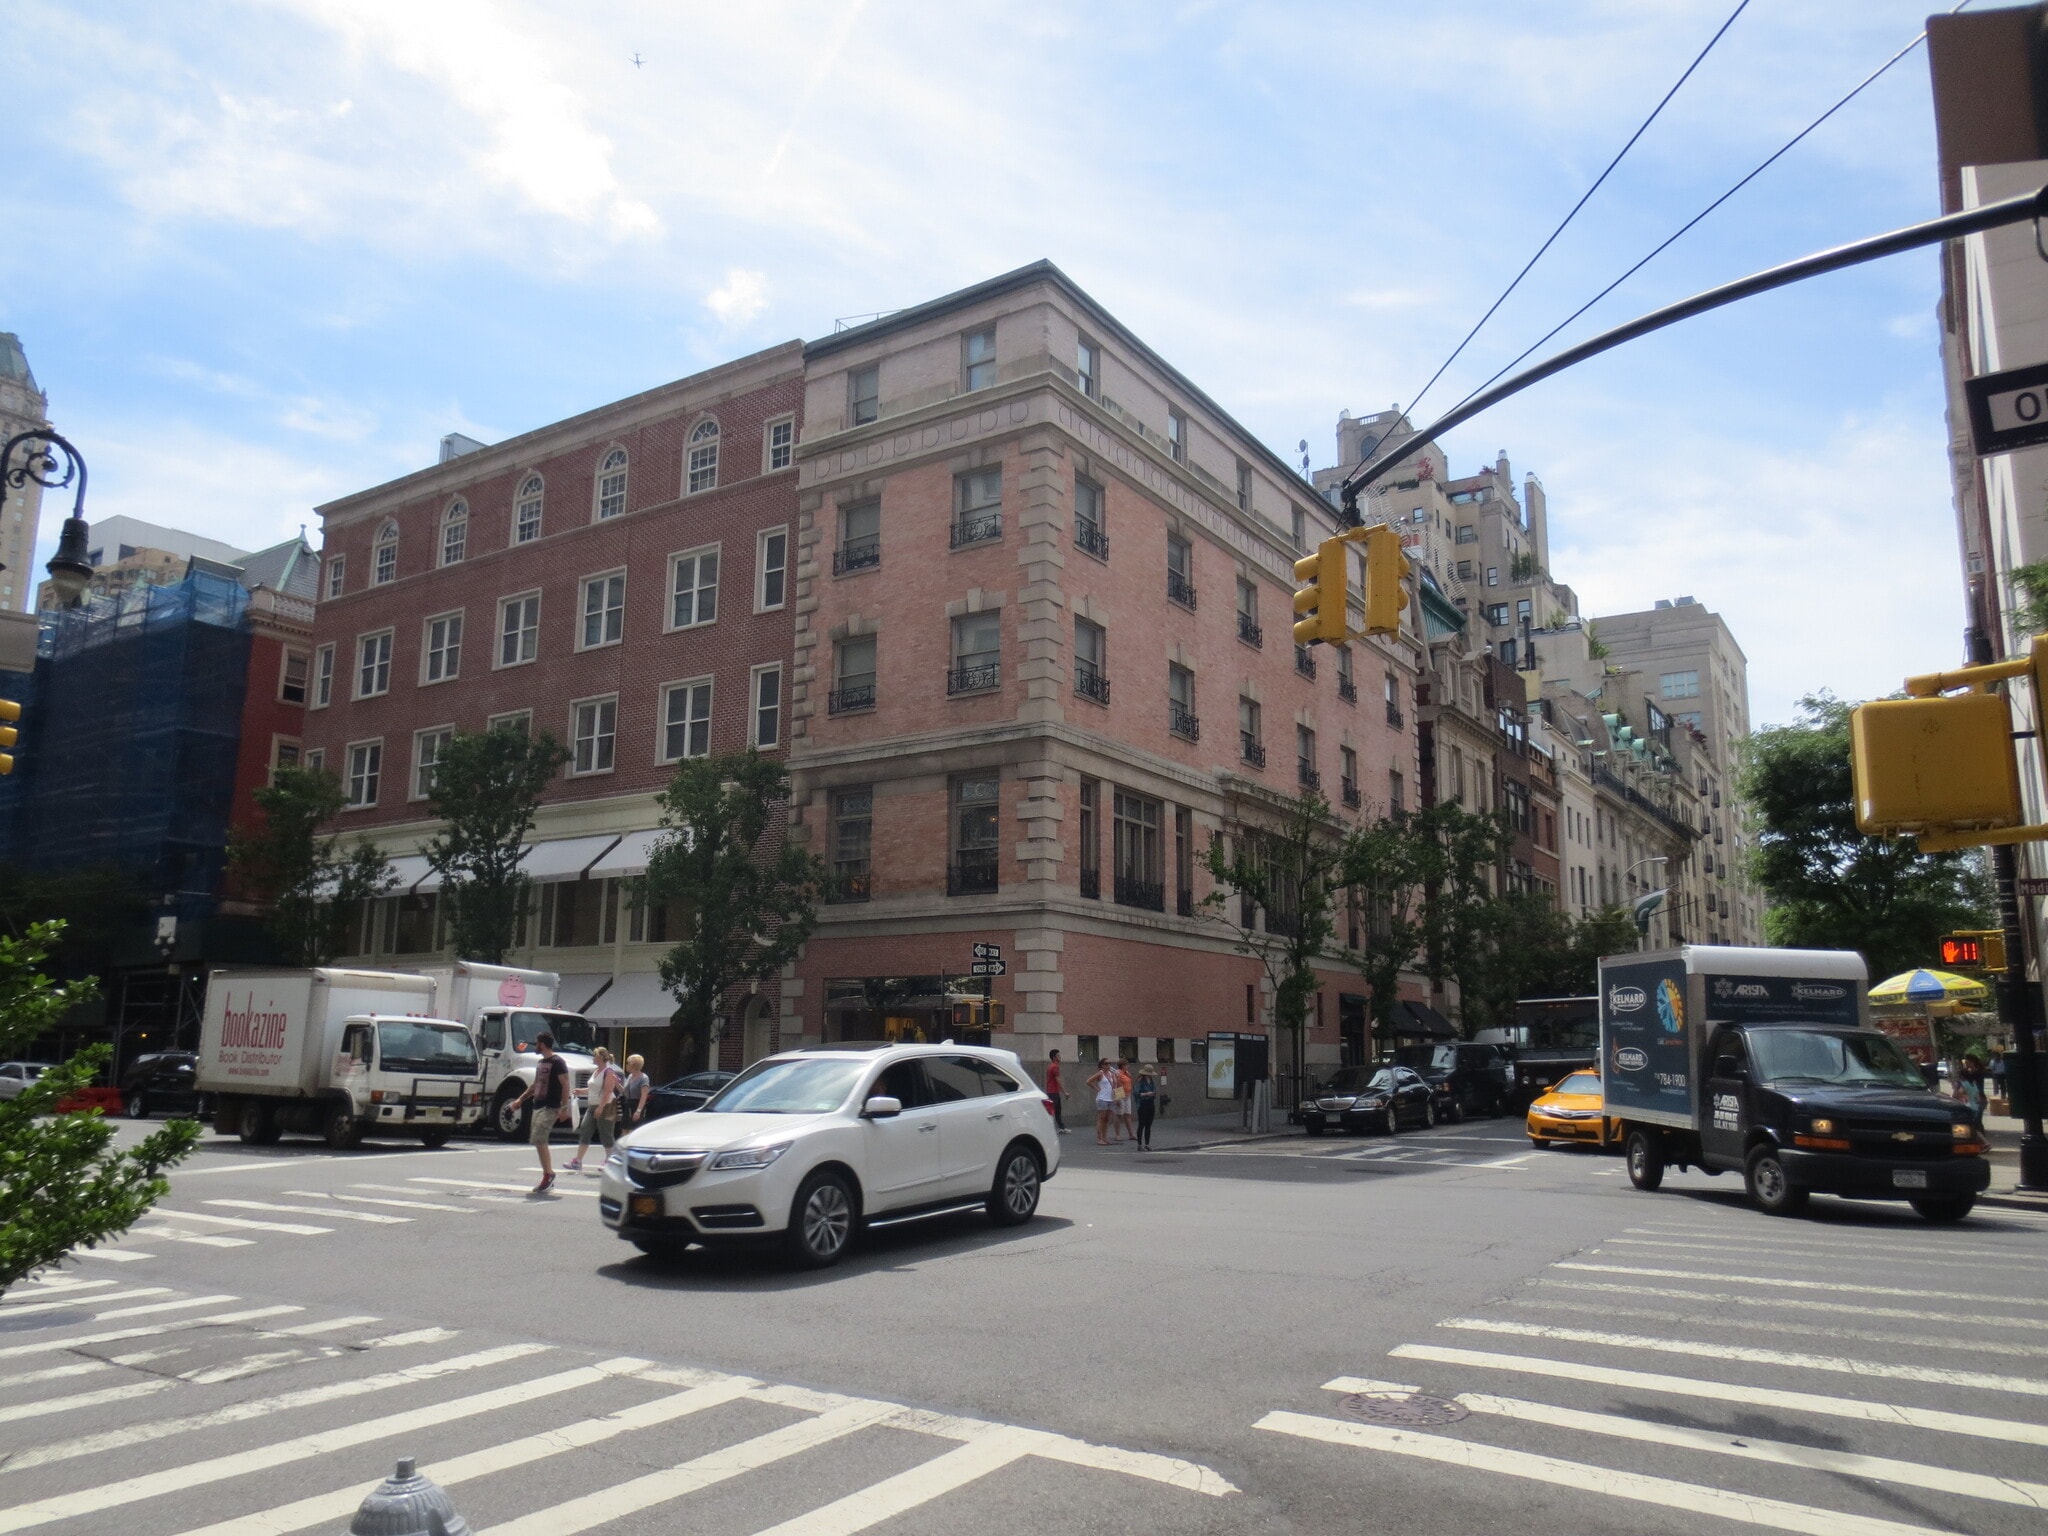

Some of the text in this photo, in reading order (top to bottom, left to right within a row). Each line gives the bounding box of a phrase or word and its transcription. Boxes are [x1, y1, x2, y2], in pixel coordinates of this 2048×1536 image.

[1963, 943, 1977, 960] 11
[1734, 984, 1844, 996] ARISTA KELNARD
[1613, 993, 1645, 1004] KELNARD
[221, 991, 287, 1049] bookazine
[219, 1050, 282, 1065] Book Distributor
[1619, 1052, 1643, 1061] KELNARD
[1660, 1072, 1686, 1087] 784-1900
[1720, 1095, 1740, 1108] ARISTA
